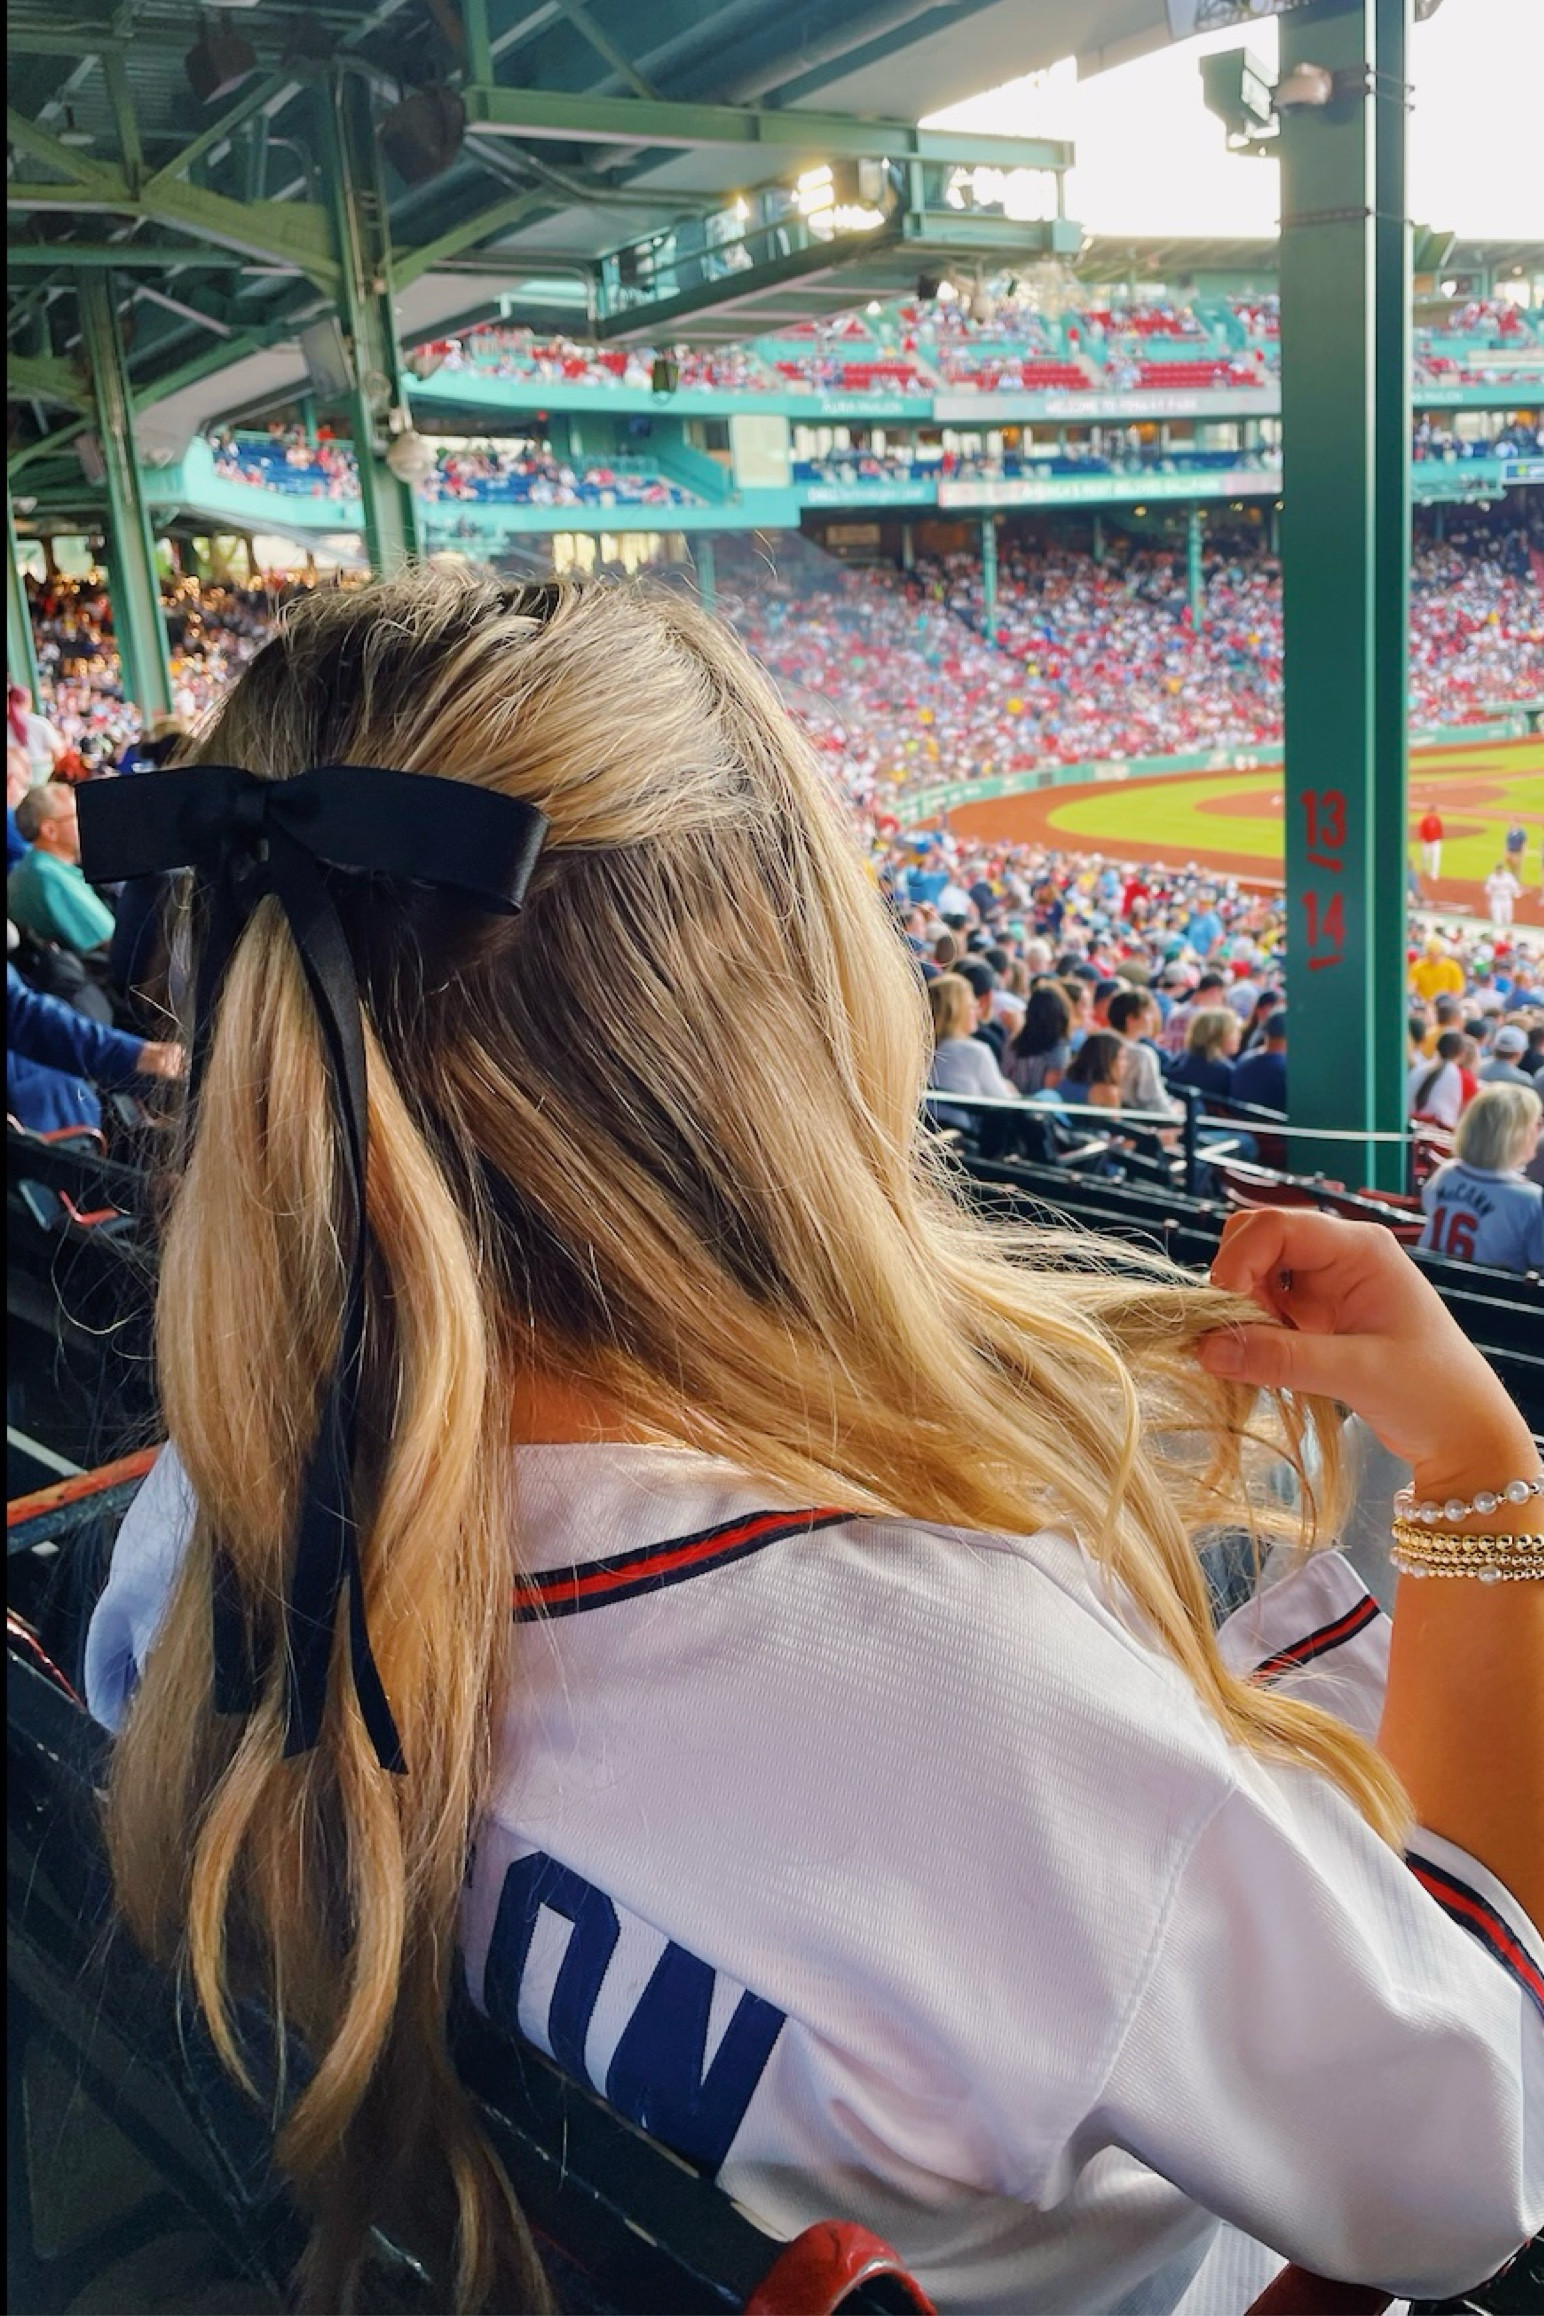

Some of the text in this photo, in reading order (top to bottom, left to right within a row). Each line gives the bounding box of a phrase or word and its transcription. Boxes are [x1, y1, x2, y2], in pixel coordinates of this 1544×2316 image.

[1301, 788, 1347, 848] 13
[1302, 890, 1347, 948] 14
[1430, 1205, 1478, 1261] 16
